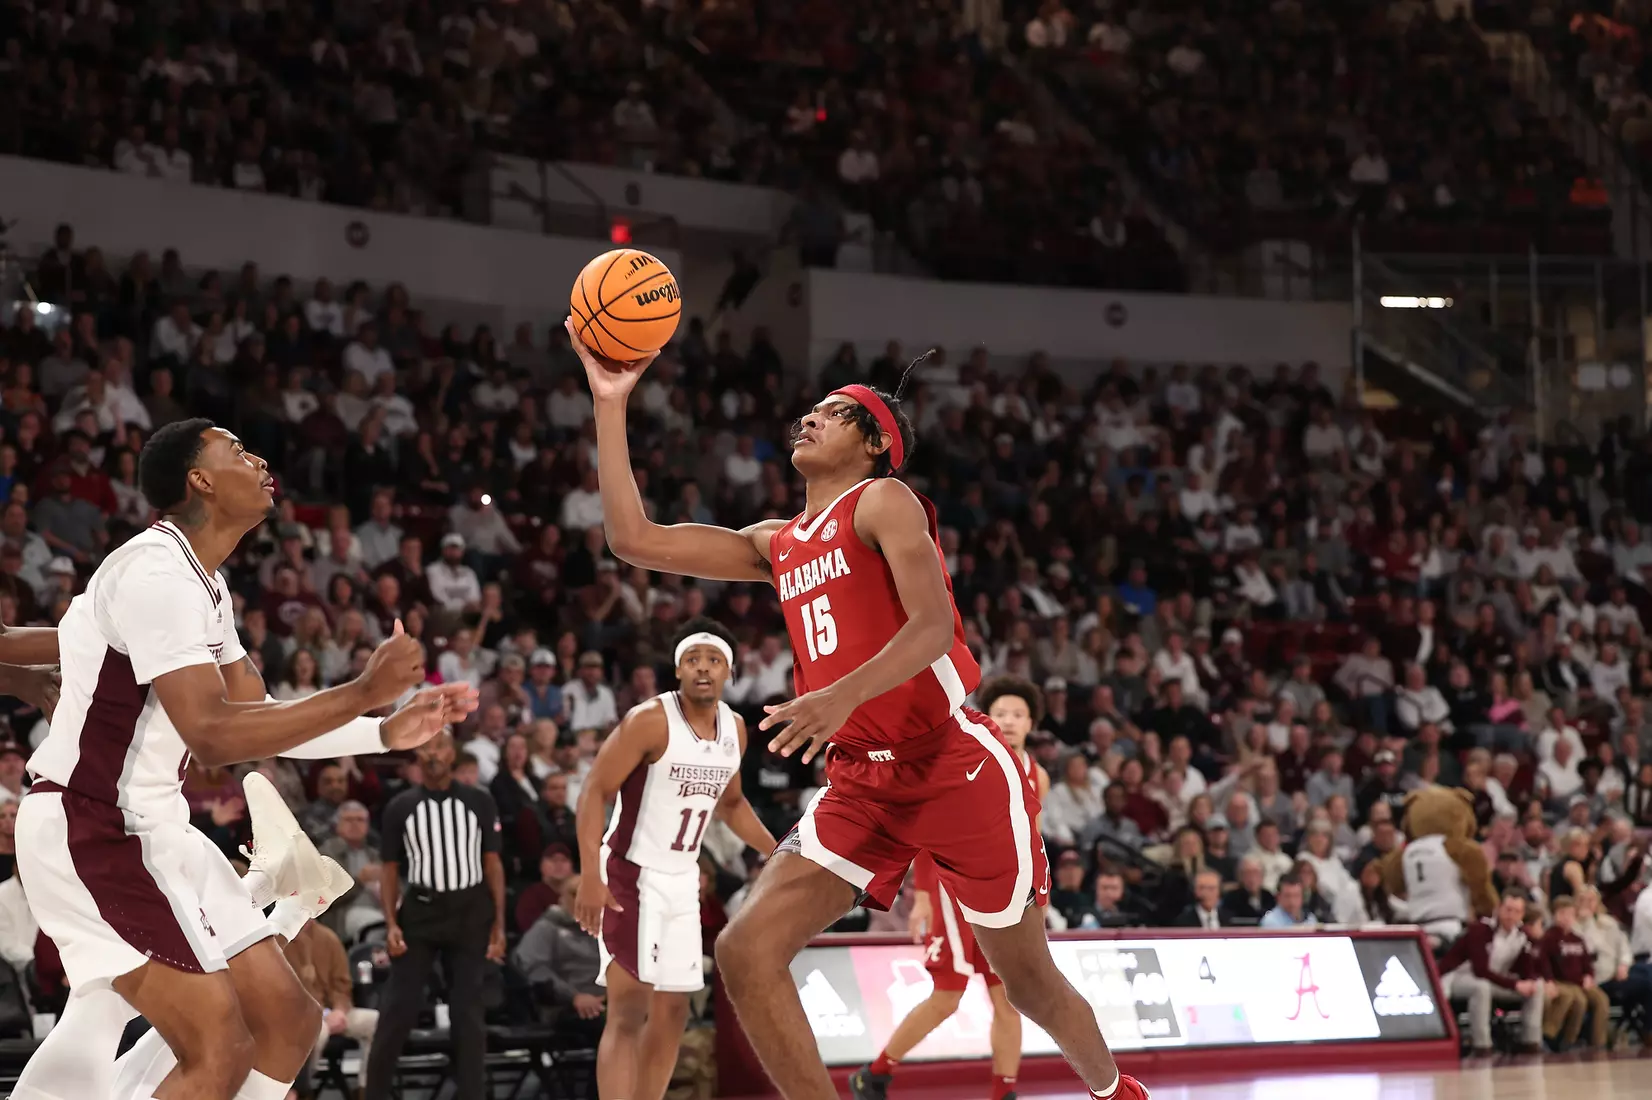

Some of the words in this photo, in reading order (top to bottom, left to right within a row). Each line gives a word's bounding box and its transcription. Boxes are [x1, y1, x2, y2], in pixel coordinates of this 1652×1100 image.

[779, 547, 851, 602] ALABAMA
[800, 593, 838, 662] 15
[867, 749, 896, 762] RTR
[669, 766, 731, 782] MISSISSIPP
[685, 782, 717, 798] STATE
[671, 808, 708, 852] 11
